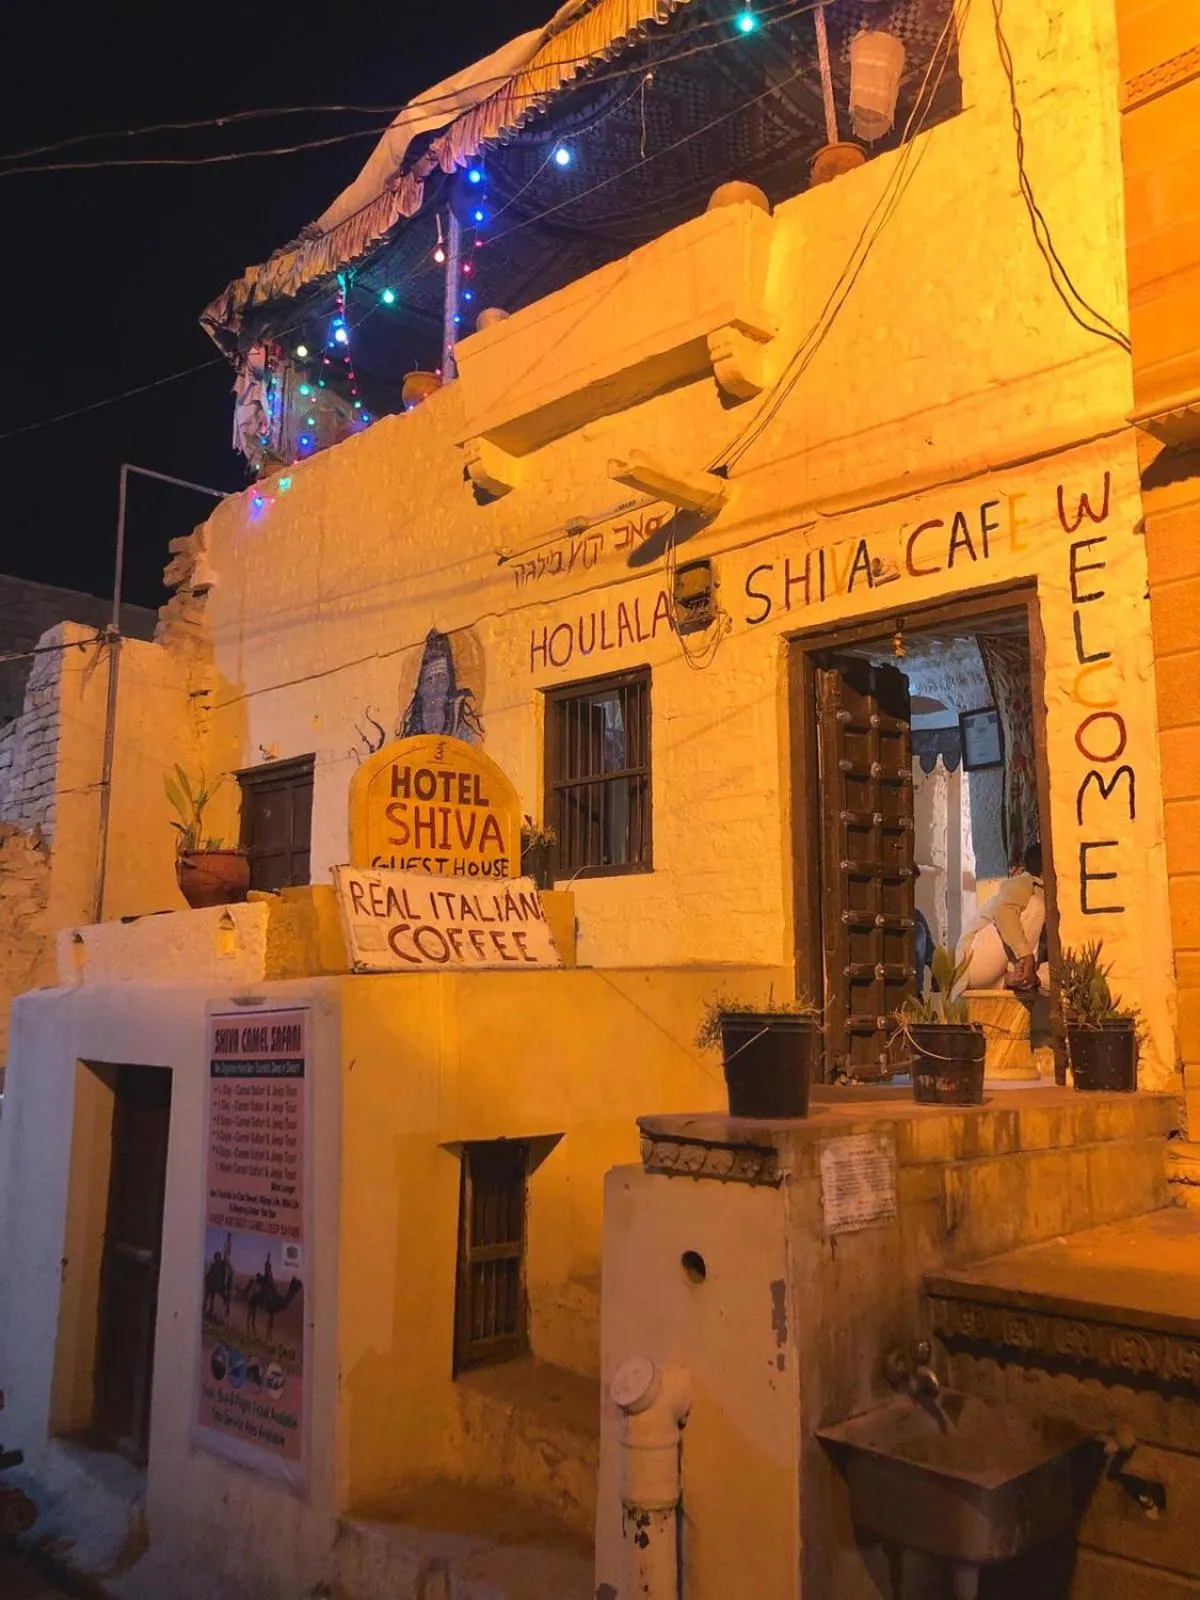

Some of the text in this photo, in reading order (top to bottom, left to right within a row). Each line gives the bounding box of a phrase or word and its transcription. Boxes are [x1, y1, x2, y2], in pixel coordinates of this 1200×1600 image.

[745, 492, 1028, 625] SHIVA CAFE
[531, 590, 674, 673] HOULALA
[1057, 471, 1136, 915] WELCOME
[390, 764, 490, 807] HOTEL
[385, 802, 505, 854] SHIVA
[453, 857, 509, 878] HOUSE
[350, 880, 541, 922] REAL ITALIAN
[387, 923, 538, 963] COFFEE
